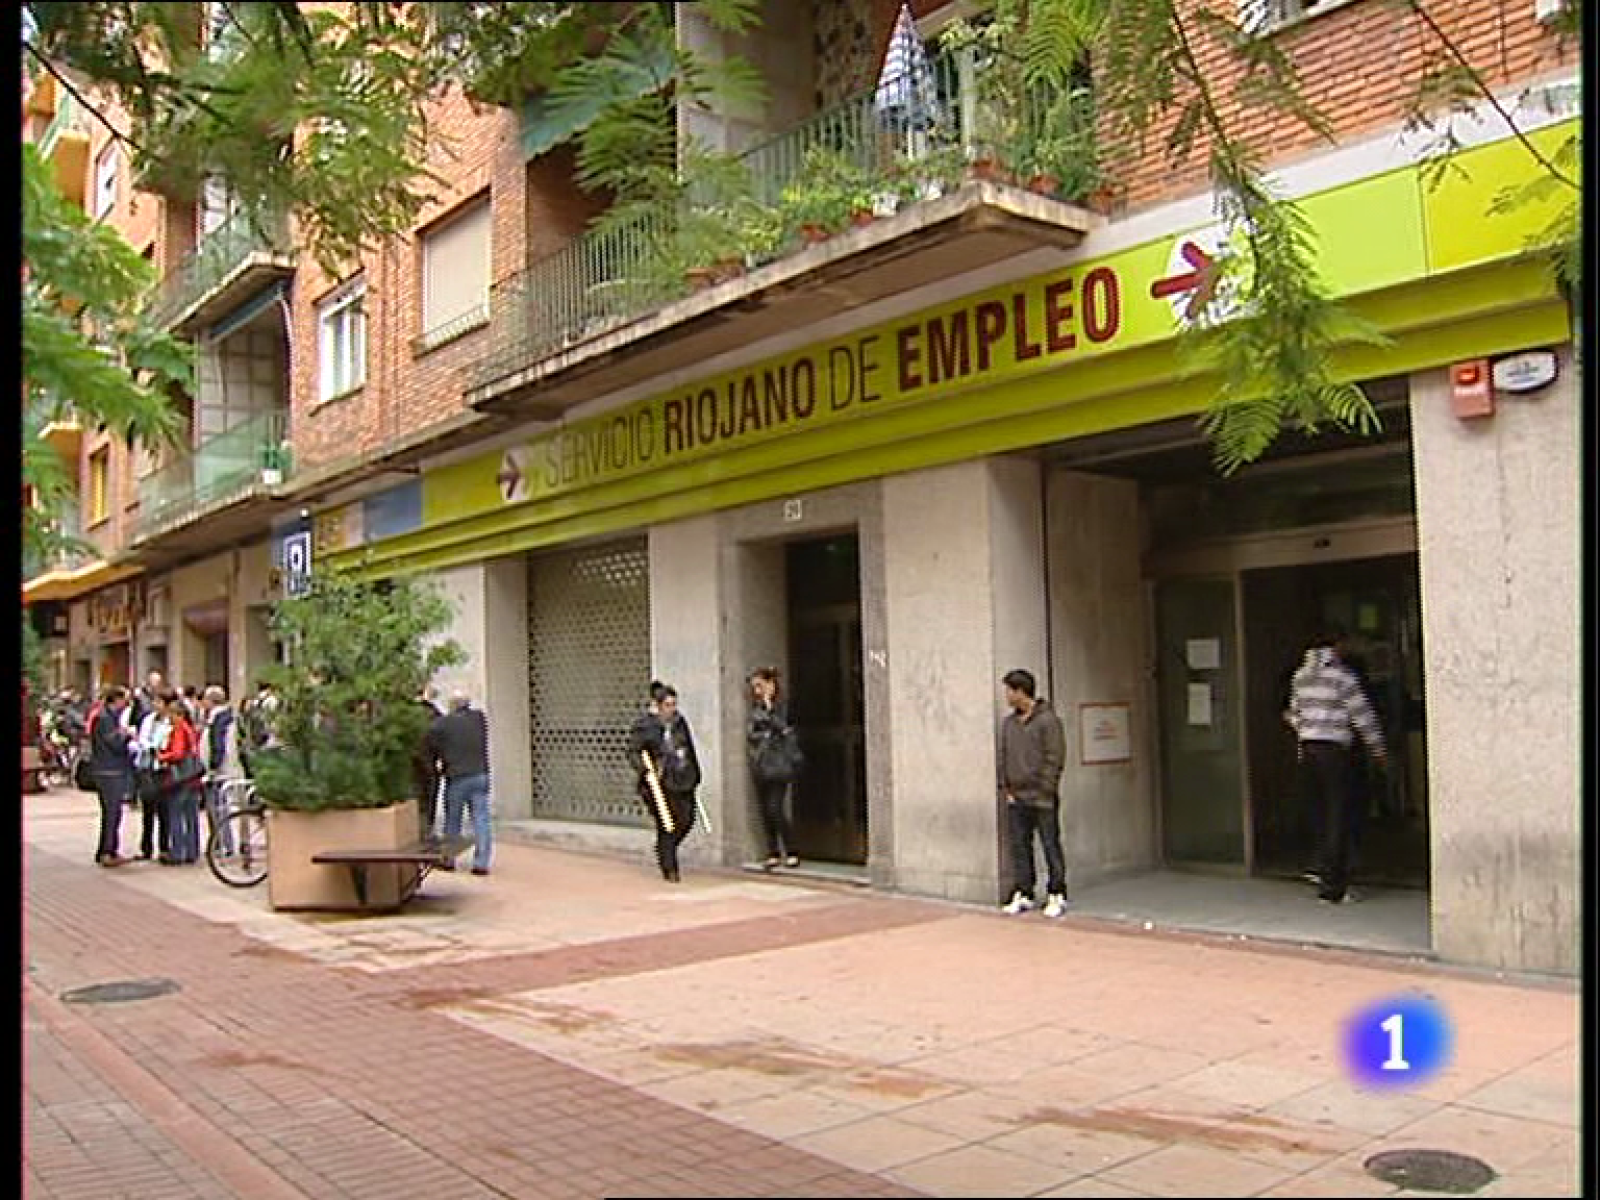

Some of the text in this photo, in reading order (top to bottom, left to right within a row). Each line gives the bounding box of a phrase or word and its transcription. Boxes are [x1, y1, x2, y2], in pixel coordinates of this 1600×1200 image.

[546, 266, 1120, 488] SERVICIO RIOJANO DE EMPLEO
